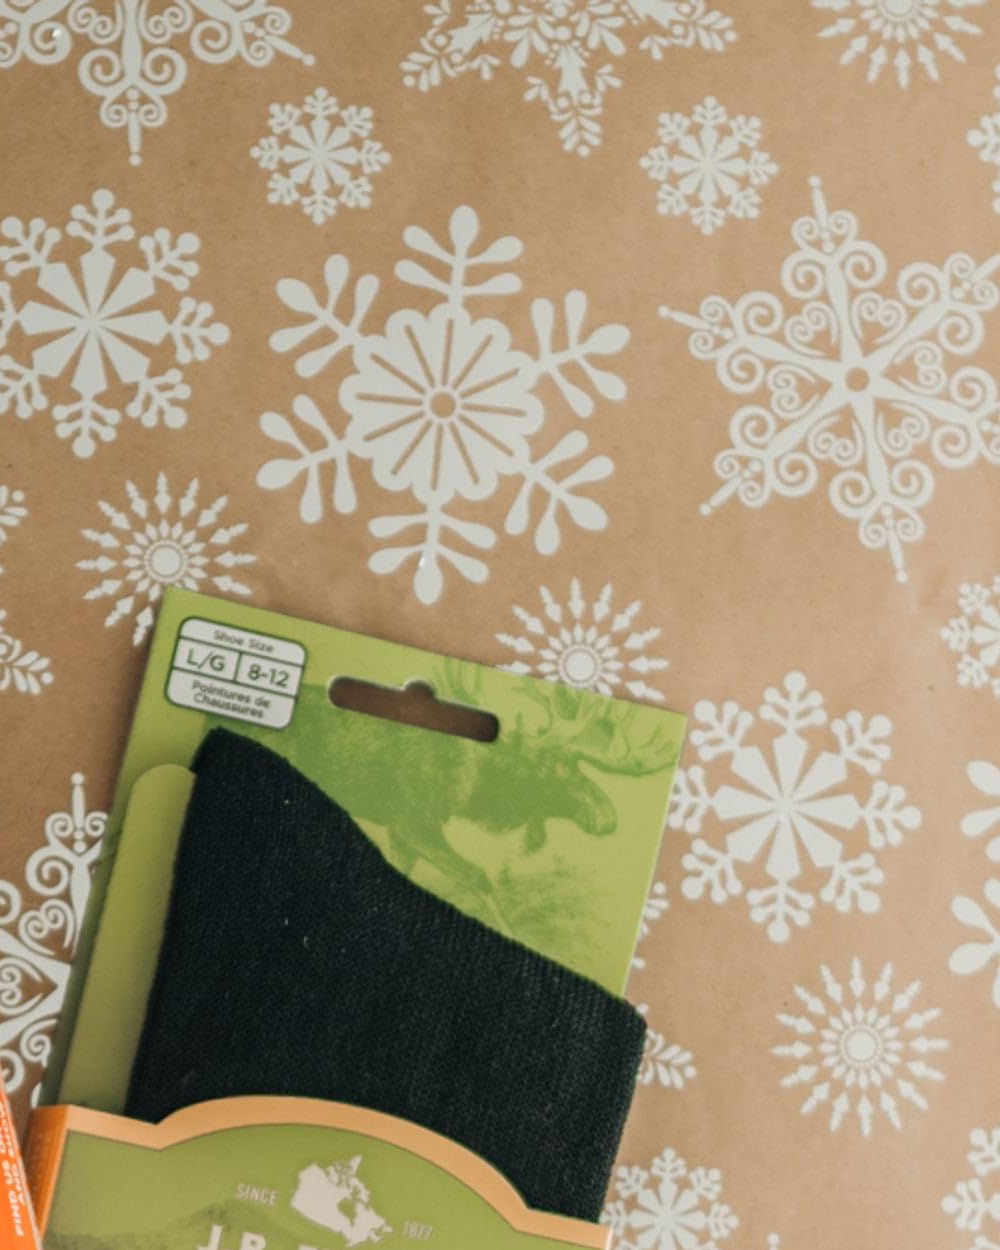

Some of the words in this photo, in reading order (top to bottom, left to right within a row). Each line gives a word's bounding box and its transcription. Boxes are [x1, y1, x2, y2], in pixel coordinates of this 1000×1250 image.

[214, 630, 244, 645] Shoe
[248, 639, 274, 652] Size
[186, 648, 225, 672] L/G
[247, 663, 289, 688] 8-12
[192, 680, 250, 703] Pointures
[254, 696, 270, 709] de
[193, 693, 263, 718] Chaussures
[237, 1183, 279, 1206] SINCE
[403, 1219, 433, 1241] 1877
